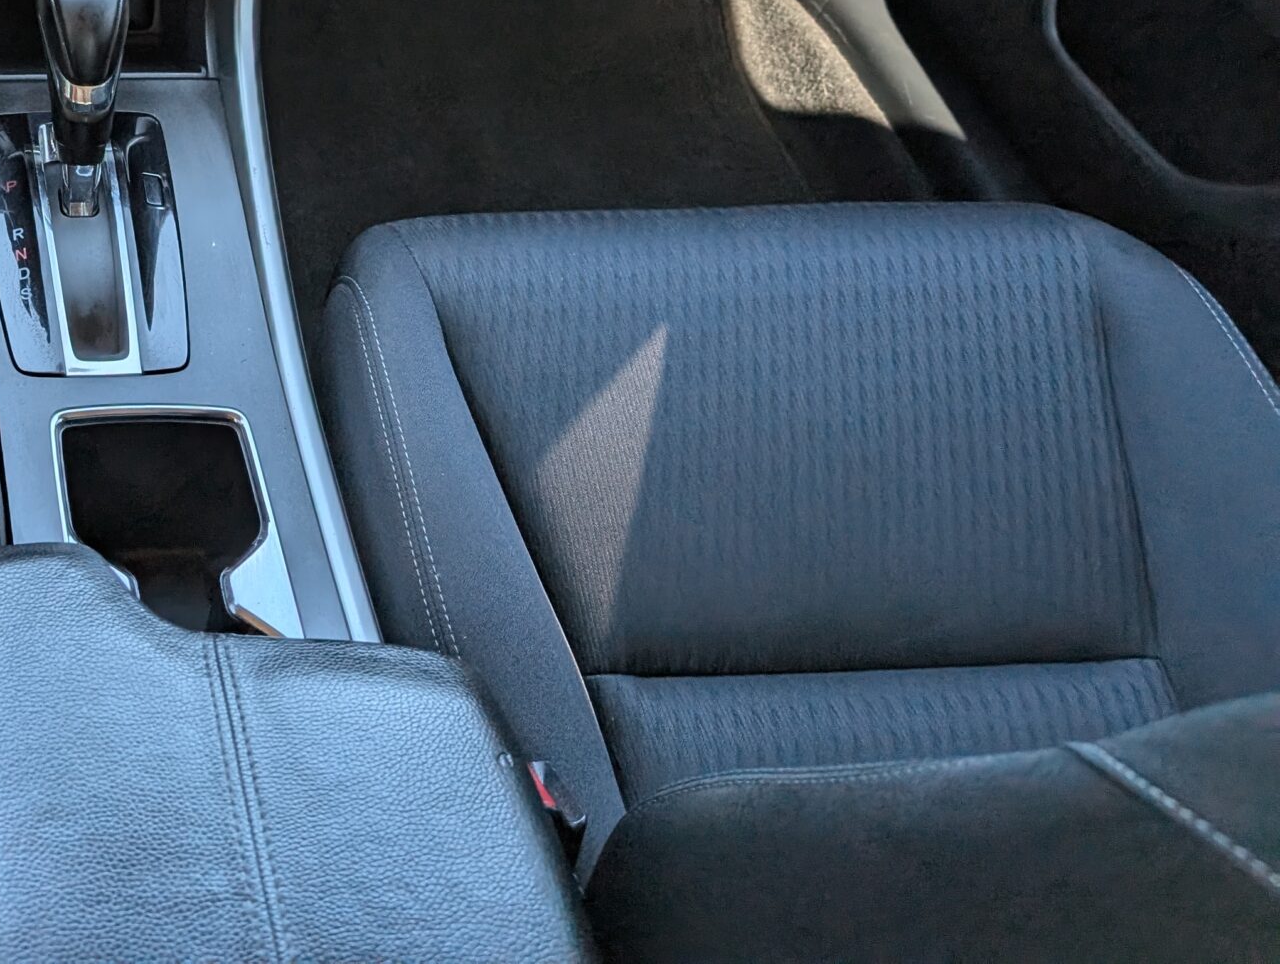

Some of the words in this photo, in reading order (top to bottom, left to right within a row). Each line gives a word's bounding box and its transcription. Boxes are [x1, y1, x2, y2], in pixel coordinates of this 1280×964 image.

[5, 180, 17, 194] P
[12, 227, 24, 241] R
[15, 247, 28, 261] N
[19, 267, 31, 280] D
[20, 287, 33, 300] S
